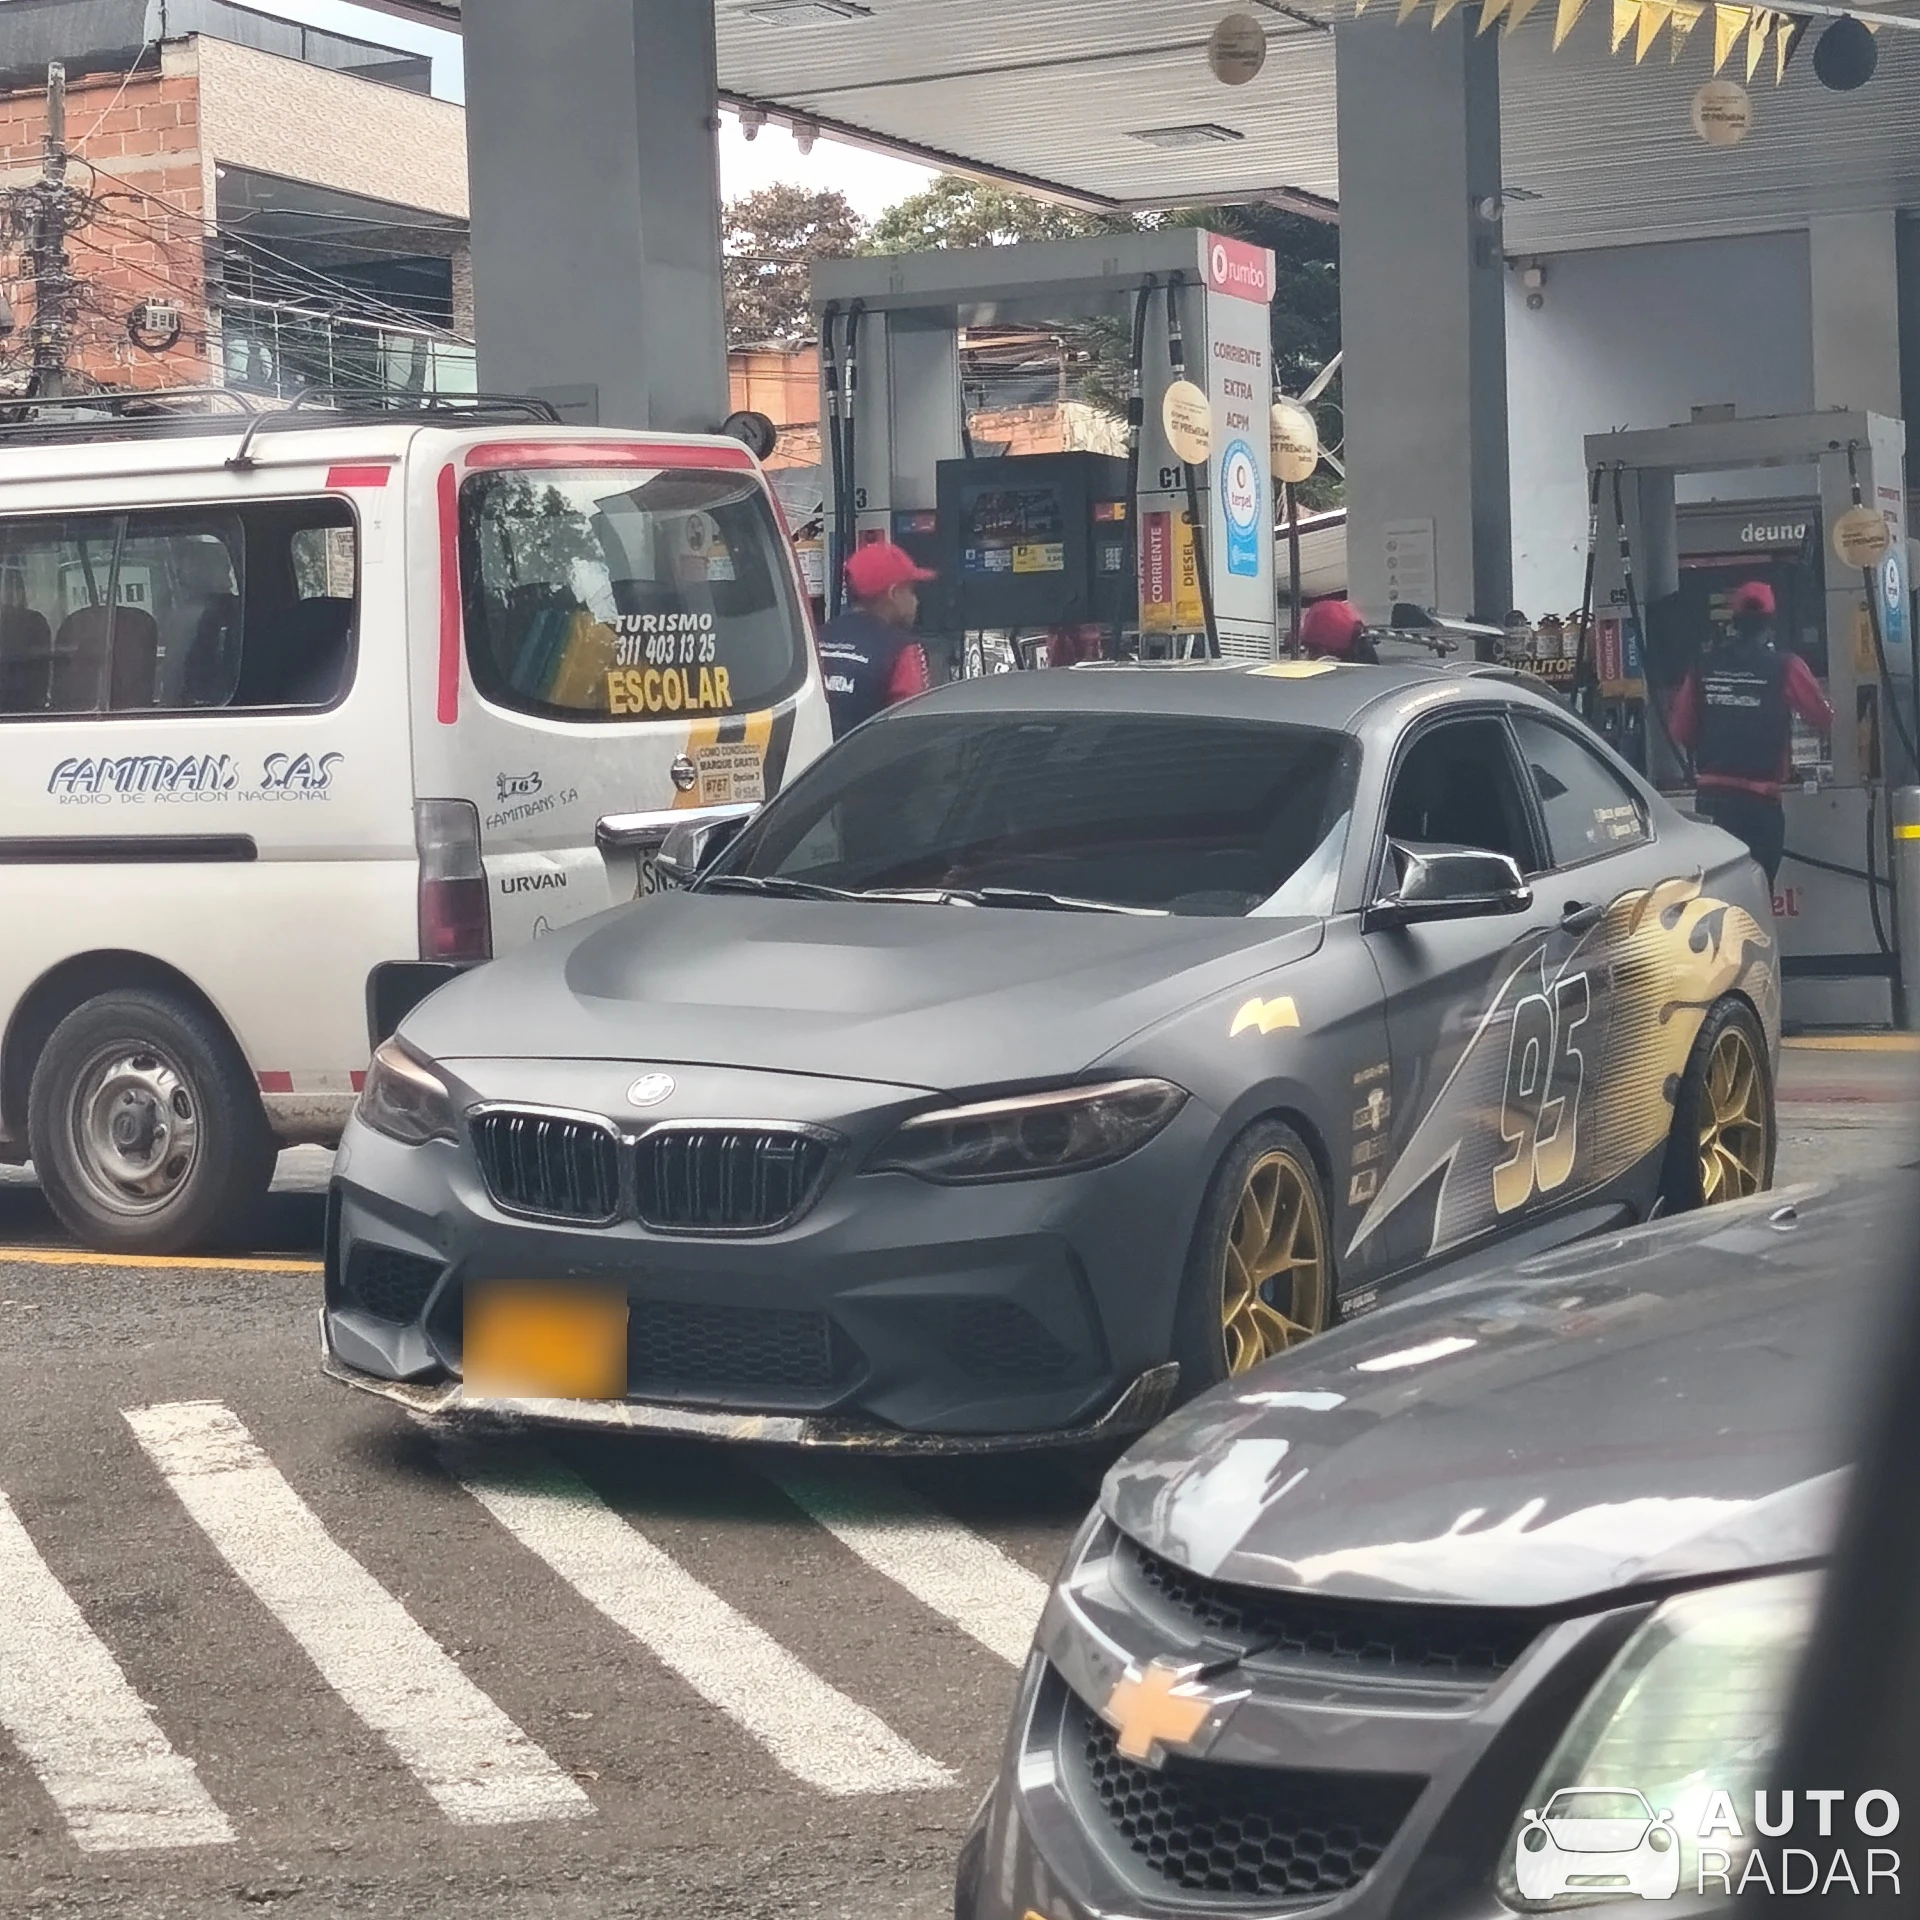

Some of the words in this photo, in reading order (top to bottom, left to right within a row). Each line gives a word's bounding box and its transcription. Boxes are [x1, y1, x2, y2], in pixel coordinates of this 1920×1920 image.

[1229, 261, 1266, 289] rumbo
[1213, 341, 1262, 368] CORRIENTE
[1223, 378, 1253, 401] EXTRA
[1226, 412, 1250, 431] ACPM
[1159, 467, 1181, 489] C1
[1231, 491, 1252, 510] terpel
[1151, 527, 1162, 603] CORRIENTE
[1182, 541, 1195, 586] DIESEL
[615, 613, 712, 633] TURISMO
[616, 635, 641, 666] 311
[645, 634, 675, 665] 403
[679, 633, 695, 664] 13
[698, 633, 716, 663] 25
[607, 666, 733, 714] ESCOLAR
[59, 793, 112, 805] RADIO
[120, 793, 146, 803] DE
[154, 792, 229, 803] ACCION
[238, 790, 331, 801] NACIONAL
[486, 795, 555, 830] FAMITRANS
[501, 872, 567, 894] URVAN
[1493, 971, 1590, 1214] 95
